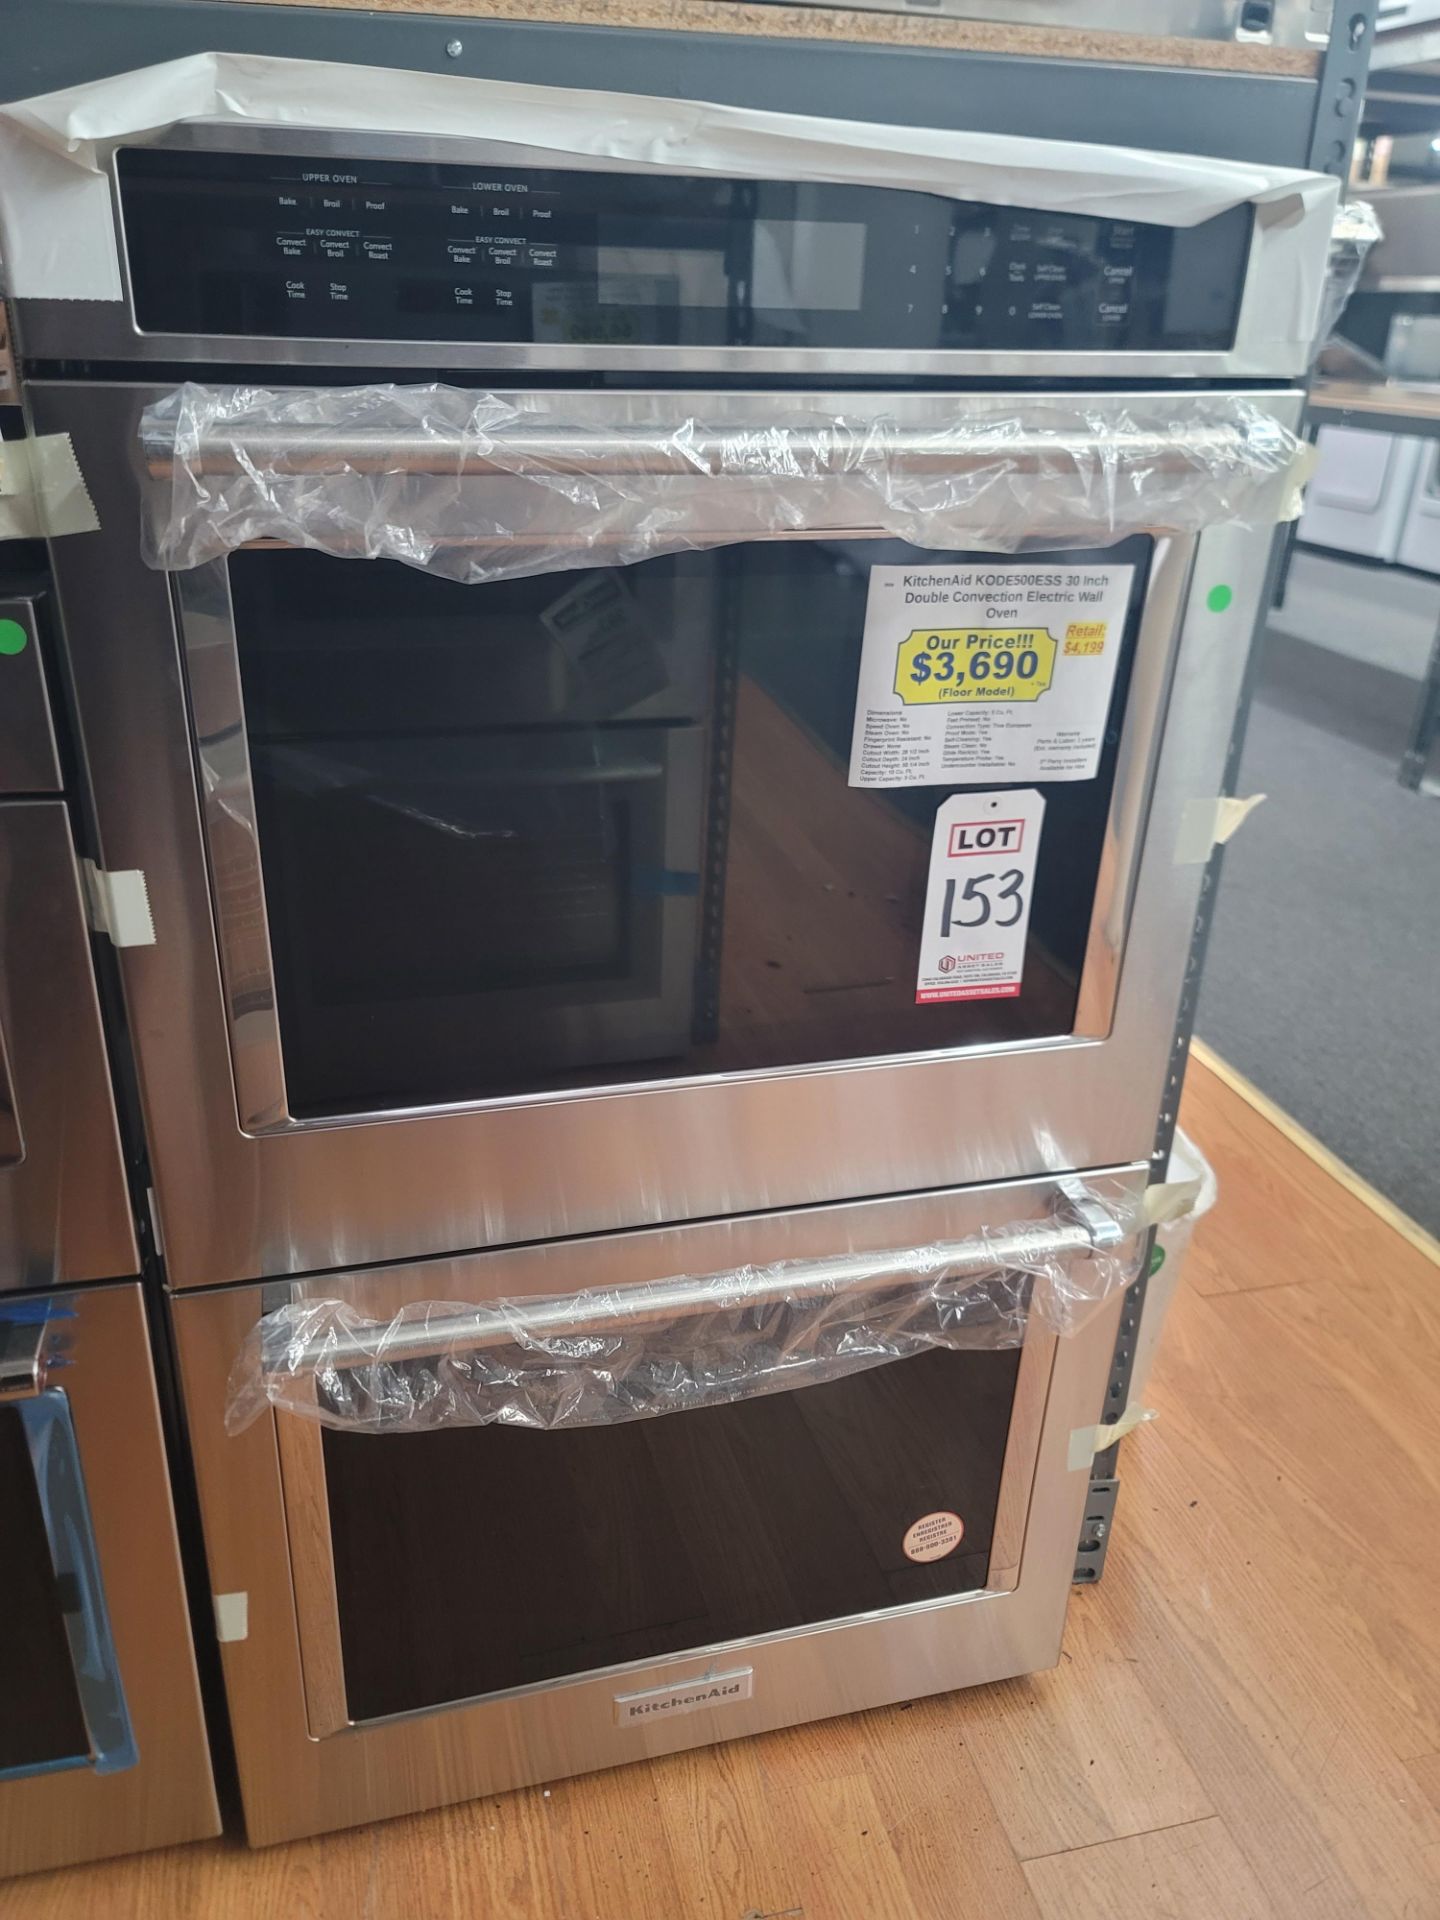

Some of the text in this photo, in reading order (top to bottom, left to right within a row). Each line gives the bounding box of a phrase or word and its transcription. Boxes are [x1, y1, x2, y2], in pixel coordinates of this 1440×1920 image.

[302, 173, 357, 183] UPPER OVEN
[472, 182, 528, 192] LOWER OVEN
[279, 197, 296, 205] Bake
[324, 200, 340, 208] Broil
[451, 205, 468, 214] Bake
[493, 208, 509, 216] Broil
[306, 228, 360, 238] EASY CONVECT
[276, 237, 306, 246] Convect
[320, 240, 350, 249] Convect
[475, 236, 526, 245] EASY CONVECT
[363, 242, 392, 251] Convect
[447, 246, 476, 254] Convect
[488, 247, 517, 256] Convect
[528, 249, 557, 258] Convect
[286, 281, 304, 290] Cook
[330, 282, 346, 292] Stop
[287, 290, 305, 298] Time
[330, 292, 348, 300] Time
[903, 574, 972, 587] KitchenAid
[976, 574, 1062, 587] KODE500ESS
[1065, 575, 1080, 586] 30
[1083, 575, 1108, 586] Inch
[905, 590, 1103, 604] Double Convection Electric Wall
[986, 607, 1018, 618] Oven
[926, 634, 1034, 650] Our Price!!!
[910, 651, 1039, 686] $3,690
[938, 686, 1014, 699] (Floor Model)
[958, 826, 1016, 850] LOT
[940, 868, 1024, 938] 153
[957, 952, 1004, 962] UNITED
[630, 1684, 740, 1716] KitchenAid
